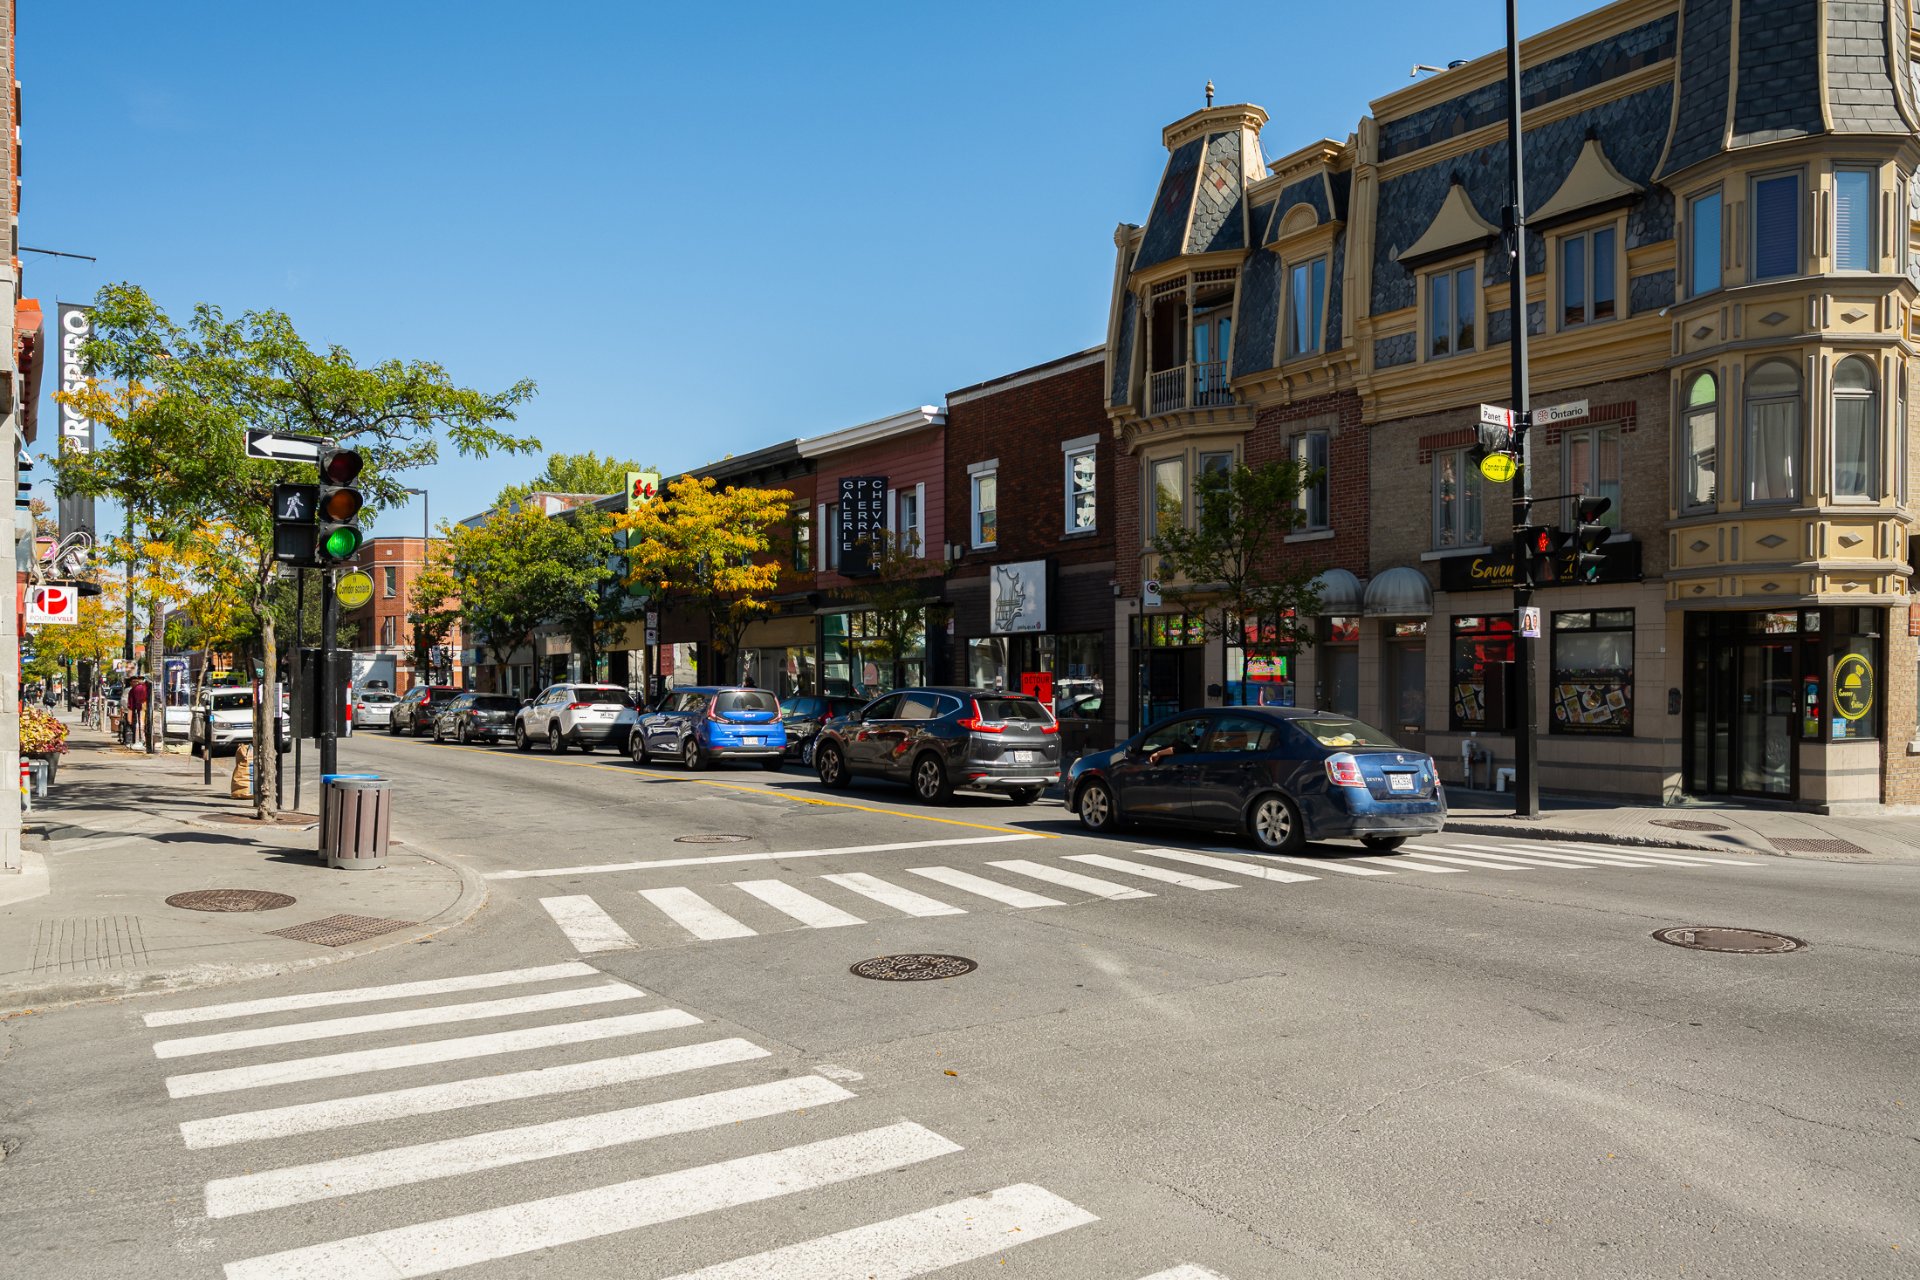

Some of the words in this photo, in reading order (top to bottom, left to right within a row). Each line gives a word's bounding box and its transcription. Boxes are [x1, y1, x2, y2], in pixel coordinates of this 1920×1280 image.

[1483, 410, 1501, 422] Panet
[1550, 407, 1583, 420] Ontario
[633, 479, 657, 497] St
[843, 481, 854, 551] GALERIE
[858, 481, 868, 540] PIERRE
[872, 480, 882, 571] CHEVALIER
